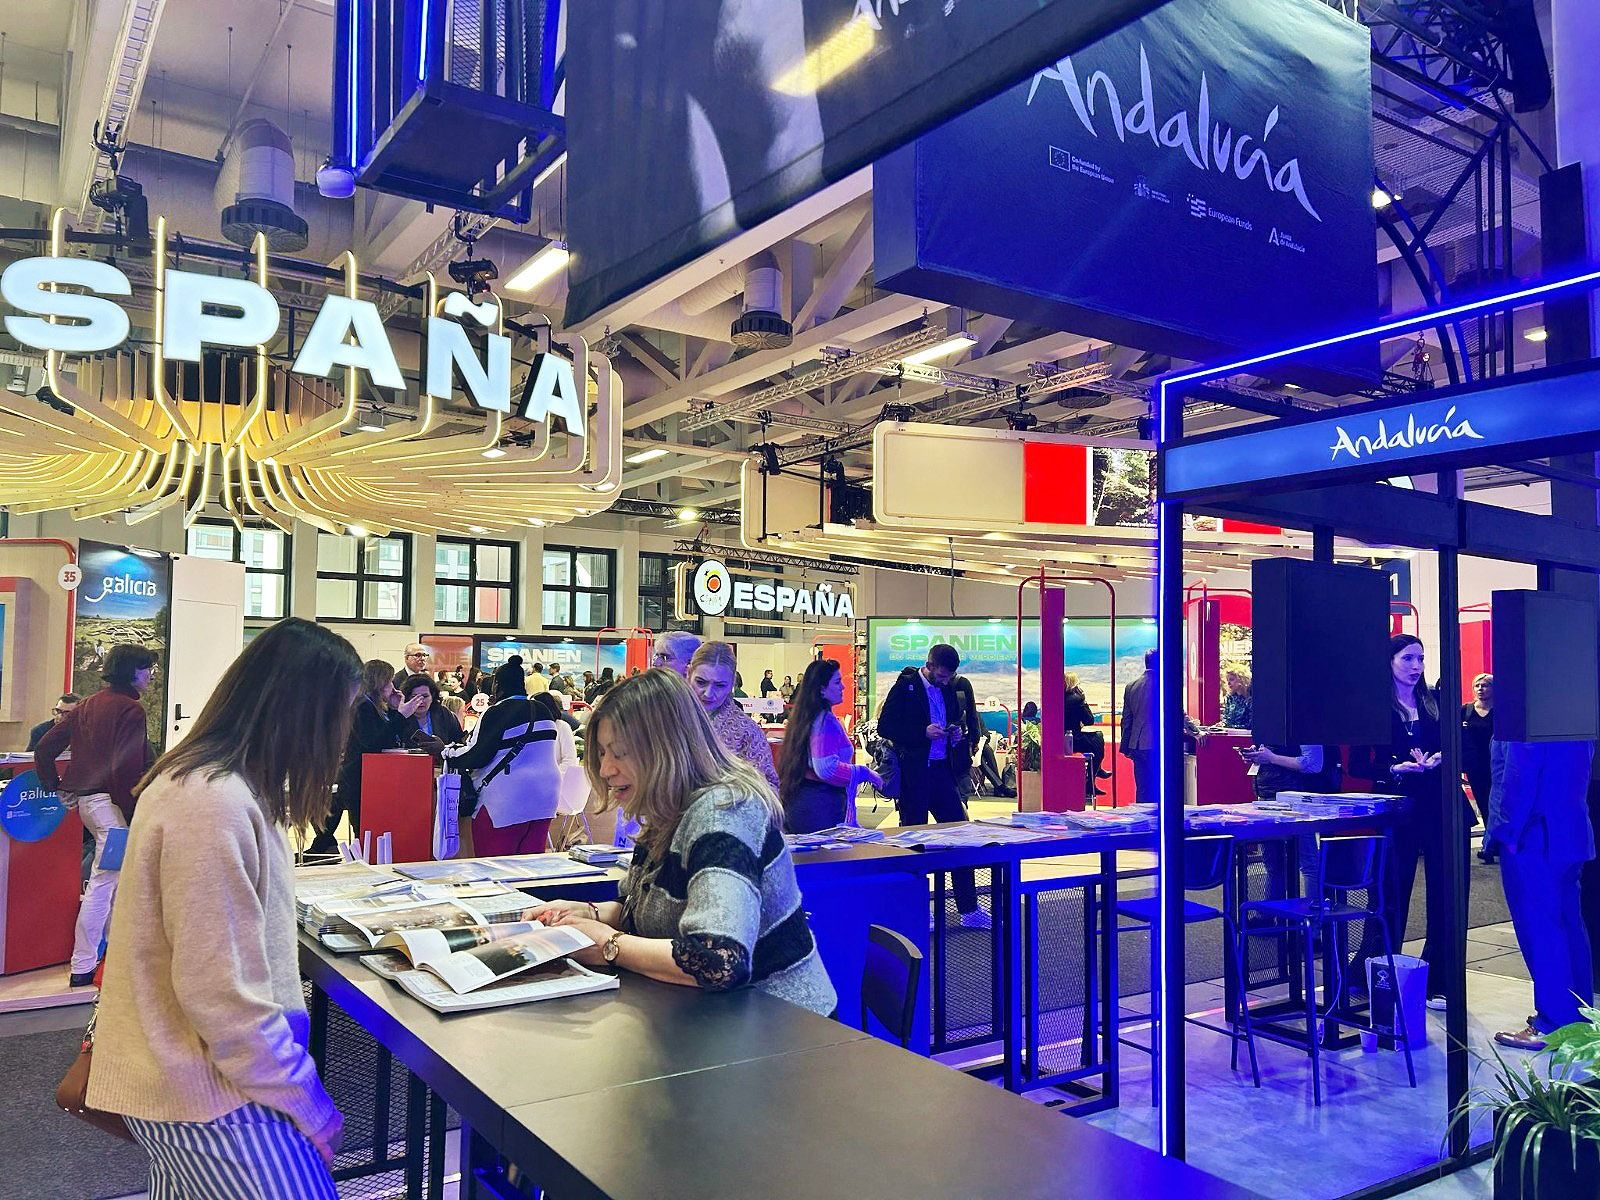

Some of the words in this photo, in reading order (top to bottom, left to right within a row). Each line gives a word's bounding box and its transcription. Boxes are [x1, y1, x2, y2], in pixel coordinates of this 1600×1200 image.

[1027, 42, 1322, 222] Andalucía
[1208, 207, 1236, 224] European
[0, 256, 586, 437] SPAÑA
[1330, 405, 1485, 461] Andalucía
[63, 571, 77, 583] 35
[84, 573, 157, 603] galicia
[733, 582, 855, 619] ESPAÑA
[889, 634, 1018, 651] SPANIEN
[475, 698, 485, 707] 25
